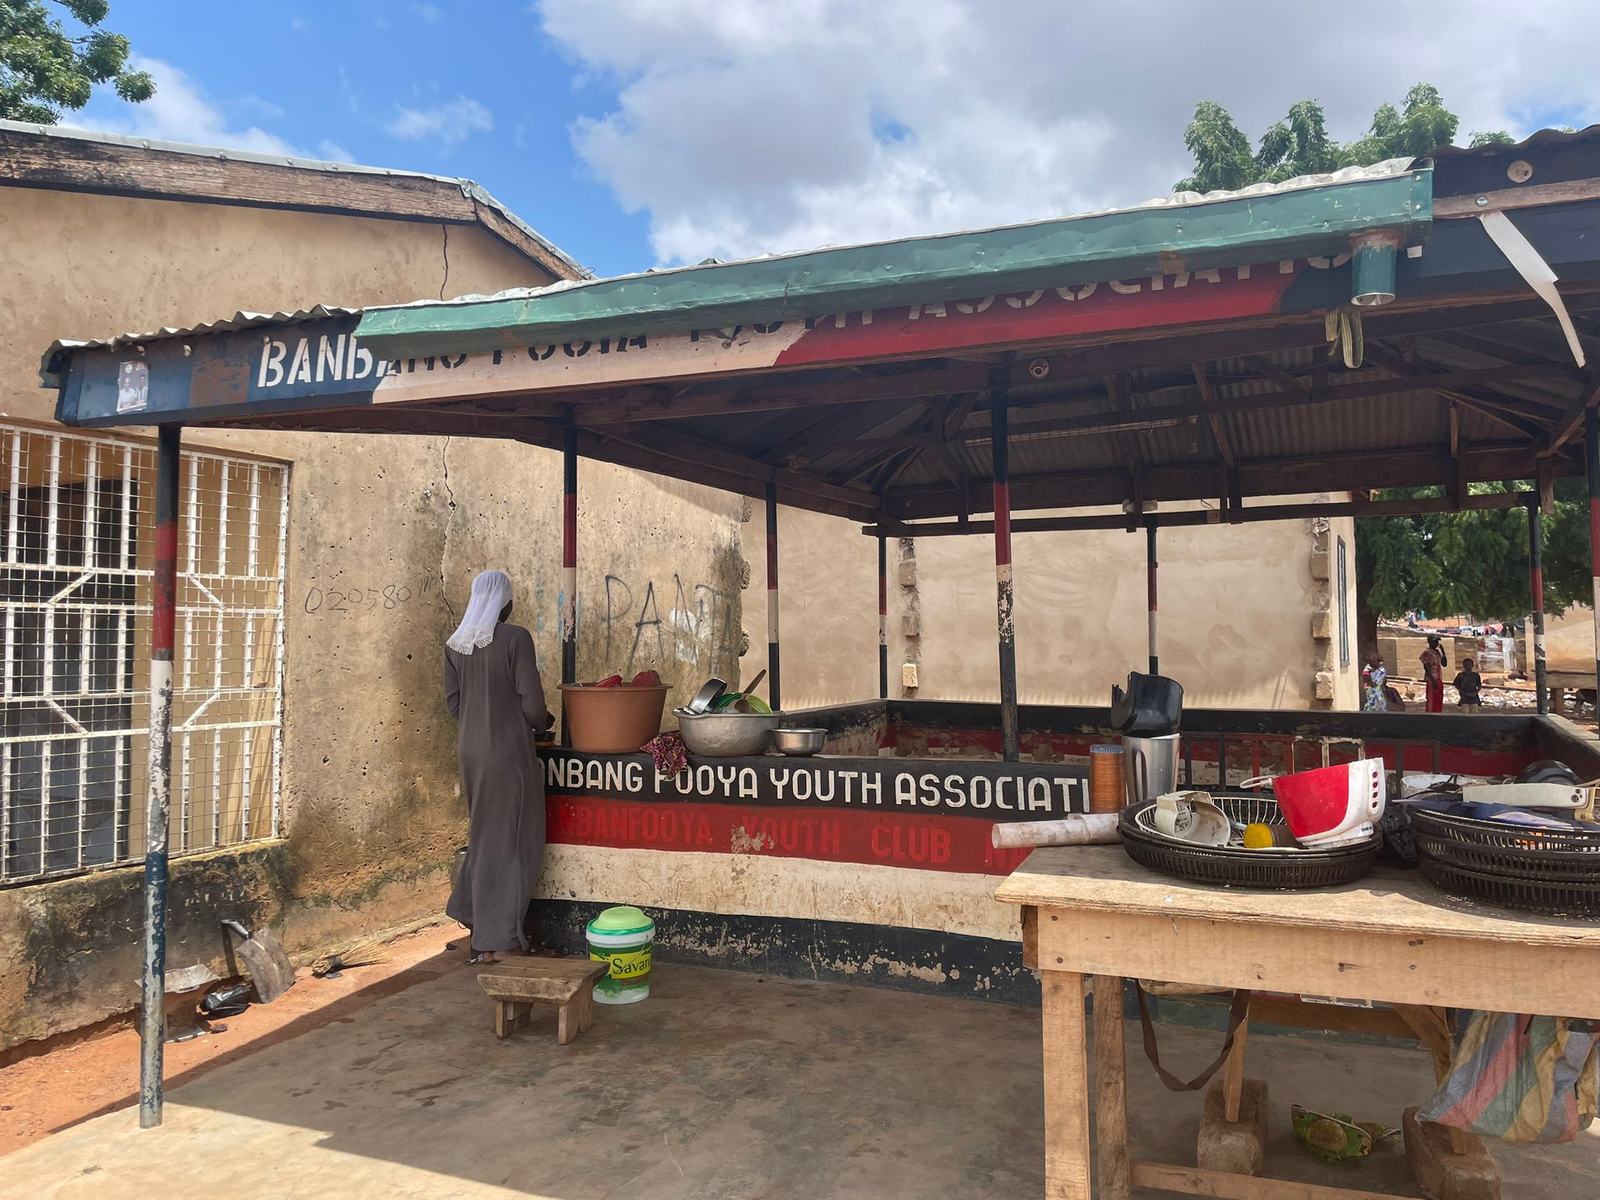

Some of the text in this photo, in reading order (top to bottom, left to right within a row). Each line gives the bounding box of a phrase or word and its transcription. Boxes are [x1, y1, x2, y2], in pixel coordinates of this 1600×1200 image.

[769, 768, 882, 804] YOUTH
[895, 771, 1090, 813] ASSOCIATI
[742, 814, 840, 854] YOUTH
[871, 823, 951, 864] CLUB
